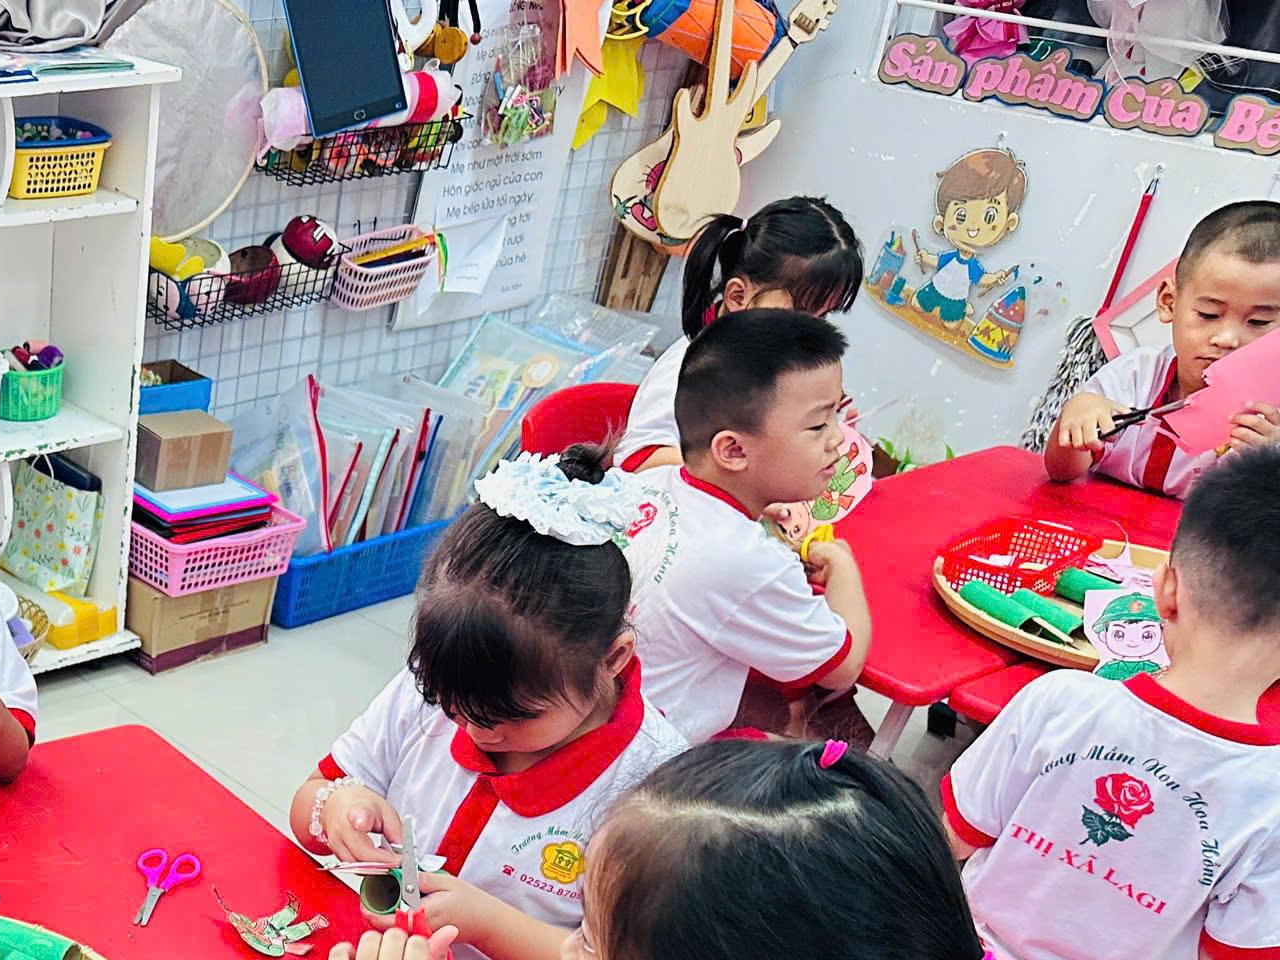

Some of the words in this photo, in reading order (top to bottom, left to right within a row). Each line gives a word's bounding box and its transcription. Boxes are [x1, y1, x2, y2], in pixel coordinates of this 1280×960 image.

[885, 40, 958, 88] Sản
[967, 50, 1099, 115] phẩm
[1108, 81, 1203, 133] Của
[451, 161, 465, 176] Mẹ
[503, 168, 522, 187] của
[524, 170, 543, 183] con
[446, 204, 461, 219] Mẹ
[1142, 757, 1181, 792] Non
[1182, 791, 1210, 830] Hoa
[1198, 838, 1222, 887] Hồng
[1010, 822, 1055, 858] THỊ
[1057, 848, 1098, 875] XÃ
[1103, 866, 1168, 915] LAGI
